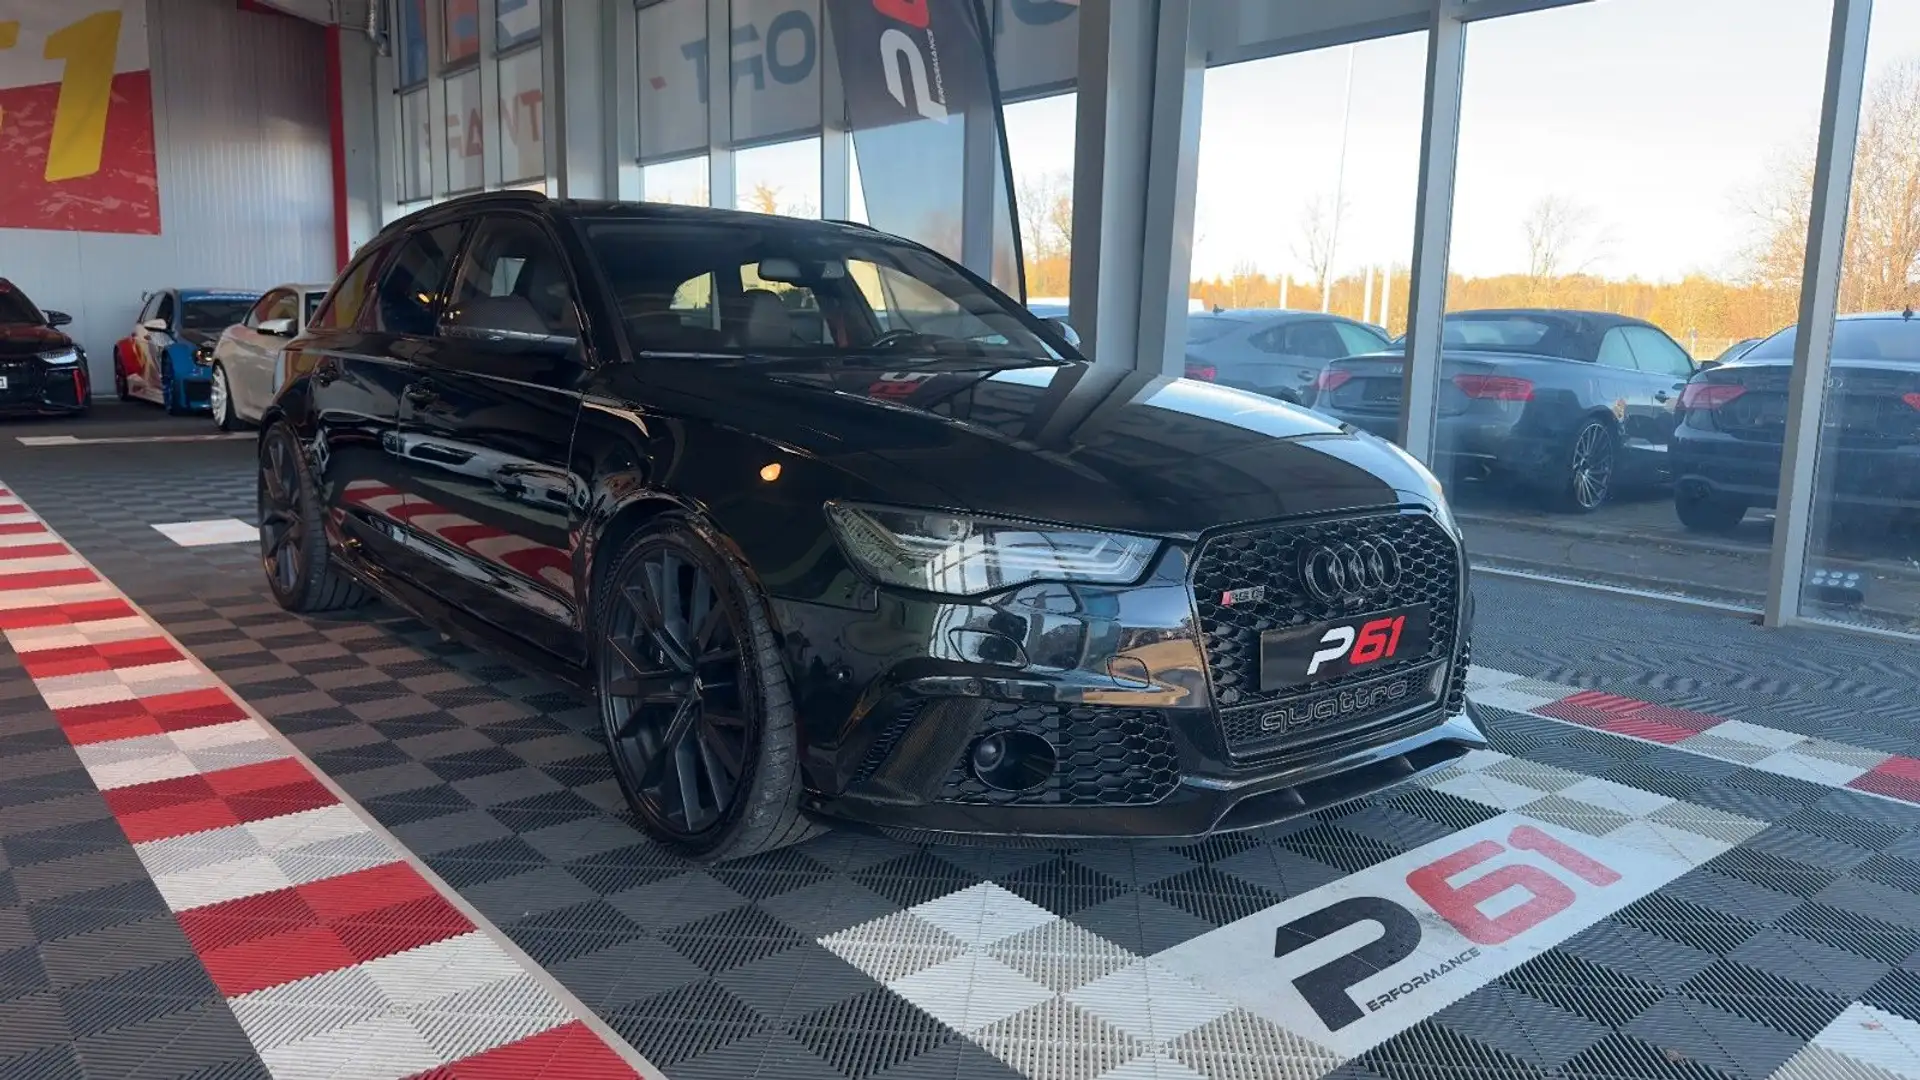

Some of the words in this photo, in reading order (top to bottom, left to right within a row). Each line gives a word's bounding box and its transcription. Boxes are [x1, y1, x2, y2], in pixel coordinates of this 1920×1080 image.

[1306, 615, 1405, 676] P61
[1260, 680, 1408, 733] quattro
[1274, 825, 1622, 1032] P61
